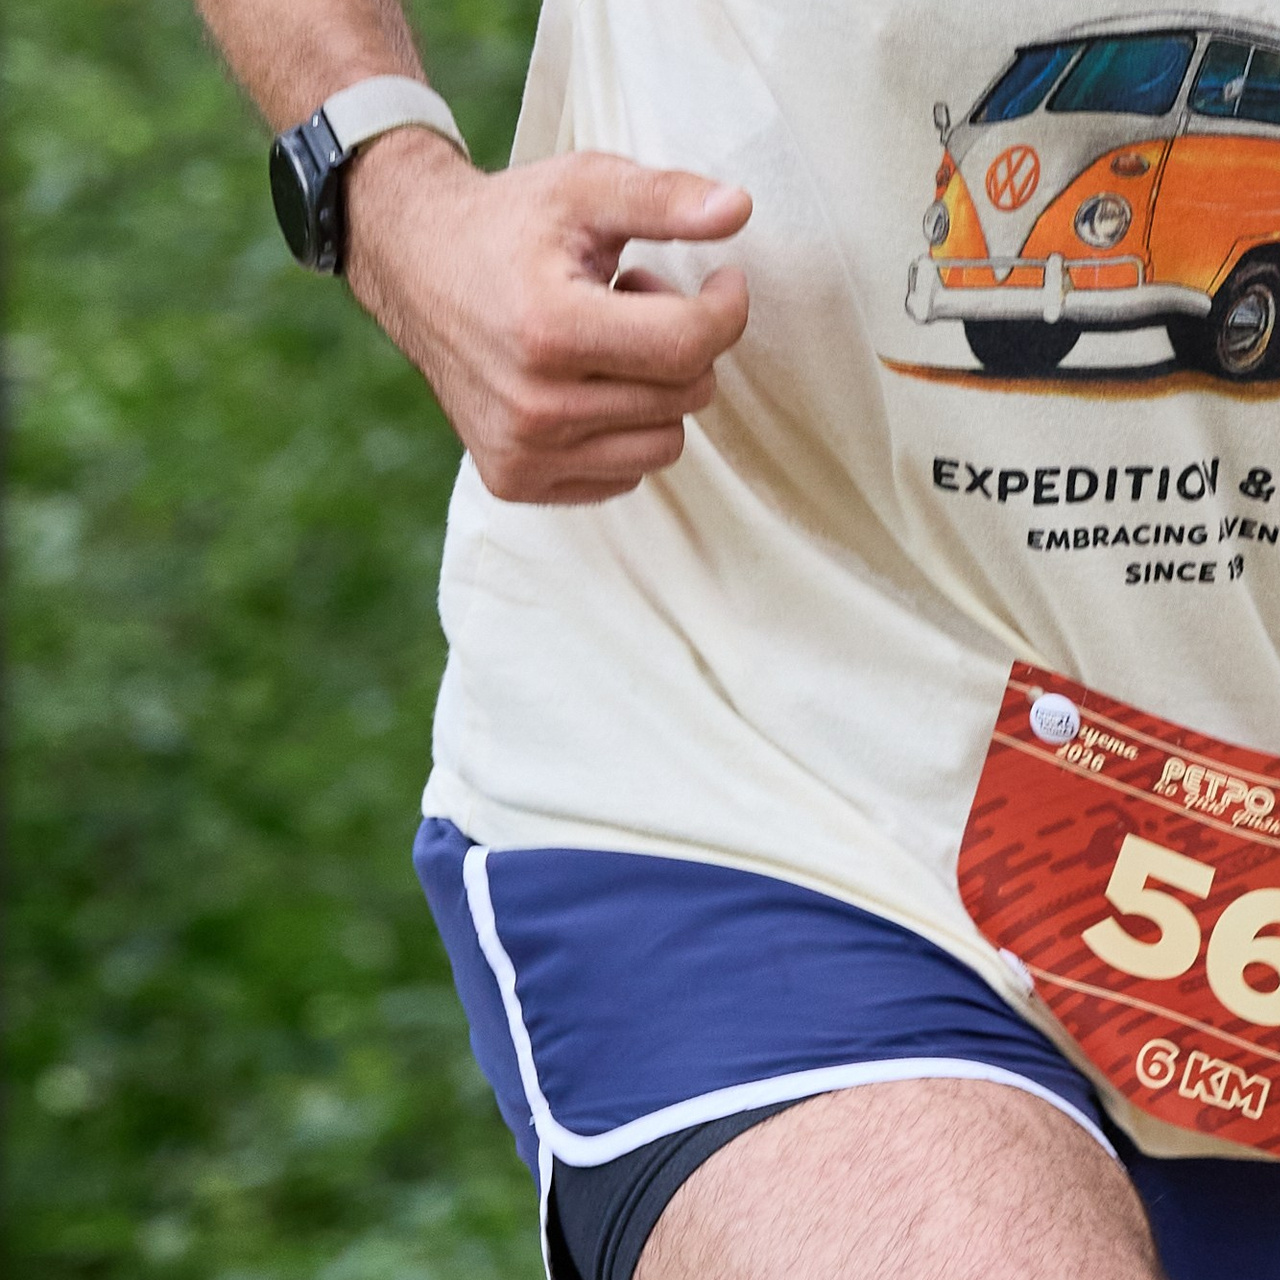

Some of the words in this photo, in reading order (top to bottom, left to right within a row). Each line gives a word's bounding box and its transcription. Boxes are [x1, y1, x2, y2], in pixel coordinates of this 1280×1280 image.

[933, 457, 1219, 505] EXPEDITION
[1239, 467, 1275, 503] &
[1027, 524, 1208, 551] EMBRACING
[1126, 562, 1216, 585] SINCE
[1163, 757, 1275, 817] РЕТРО
[1136, 1039, 1179, 1089] 6
